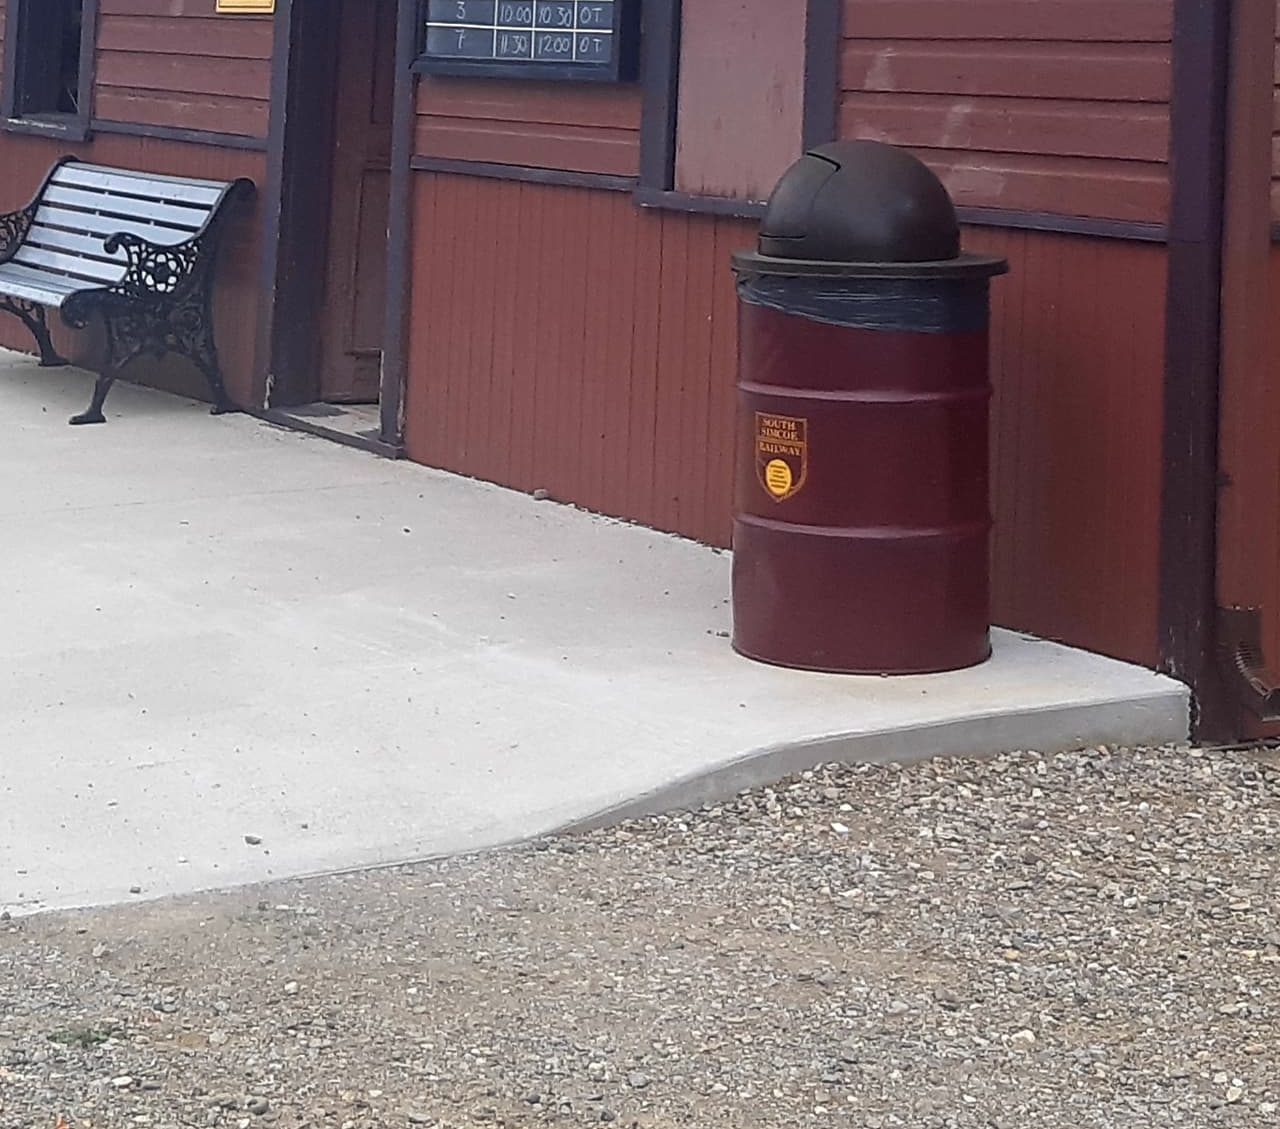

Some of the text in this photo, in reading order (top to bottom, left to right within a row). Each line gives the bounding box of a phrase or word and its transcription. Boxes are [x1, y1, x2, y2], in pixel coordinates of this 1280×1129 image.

[455, 1, 466, 19] 3
[455, 29, 466, 49] 7
[762, 418, 796, 430] SOUTH
[761, 427, 798, 440] SIMCOE
[760, 441, 801, 456] RAILWAY
